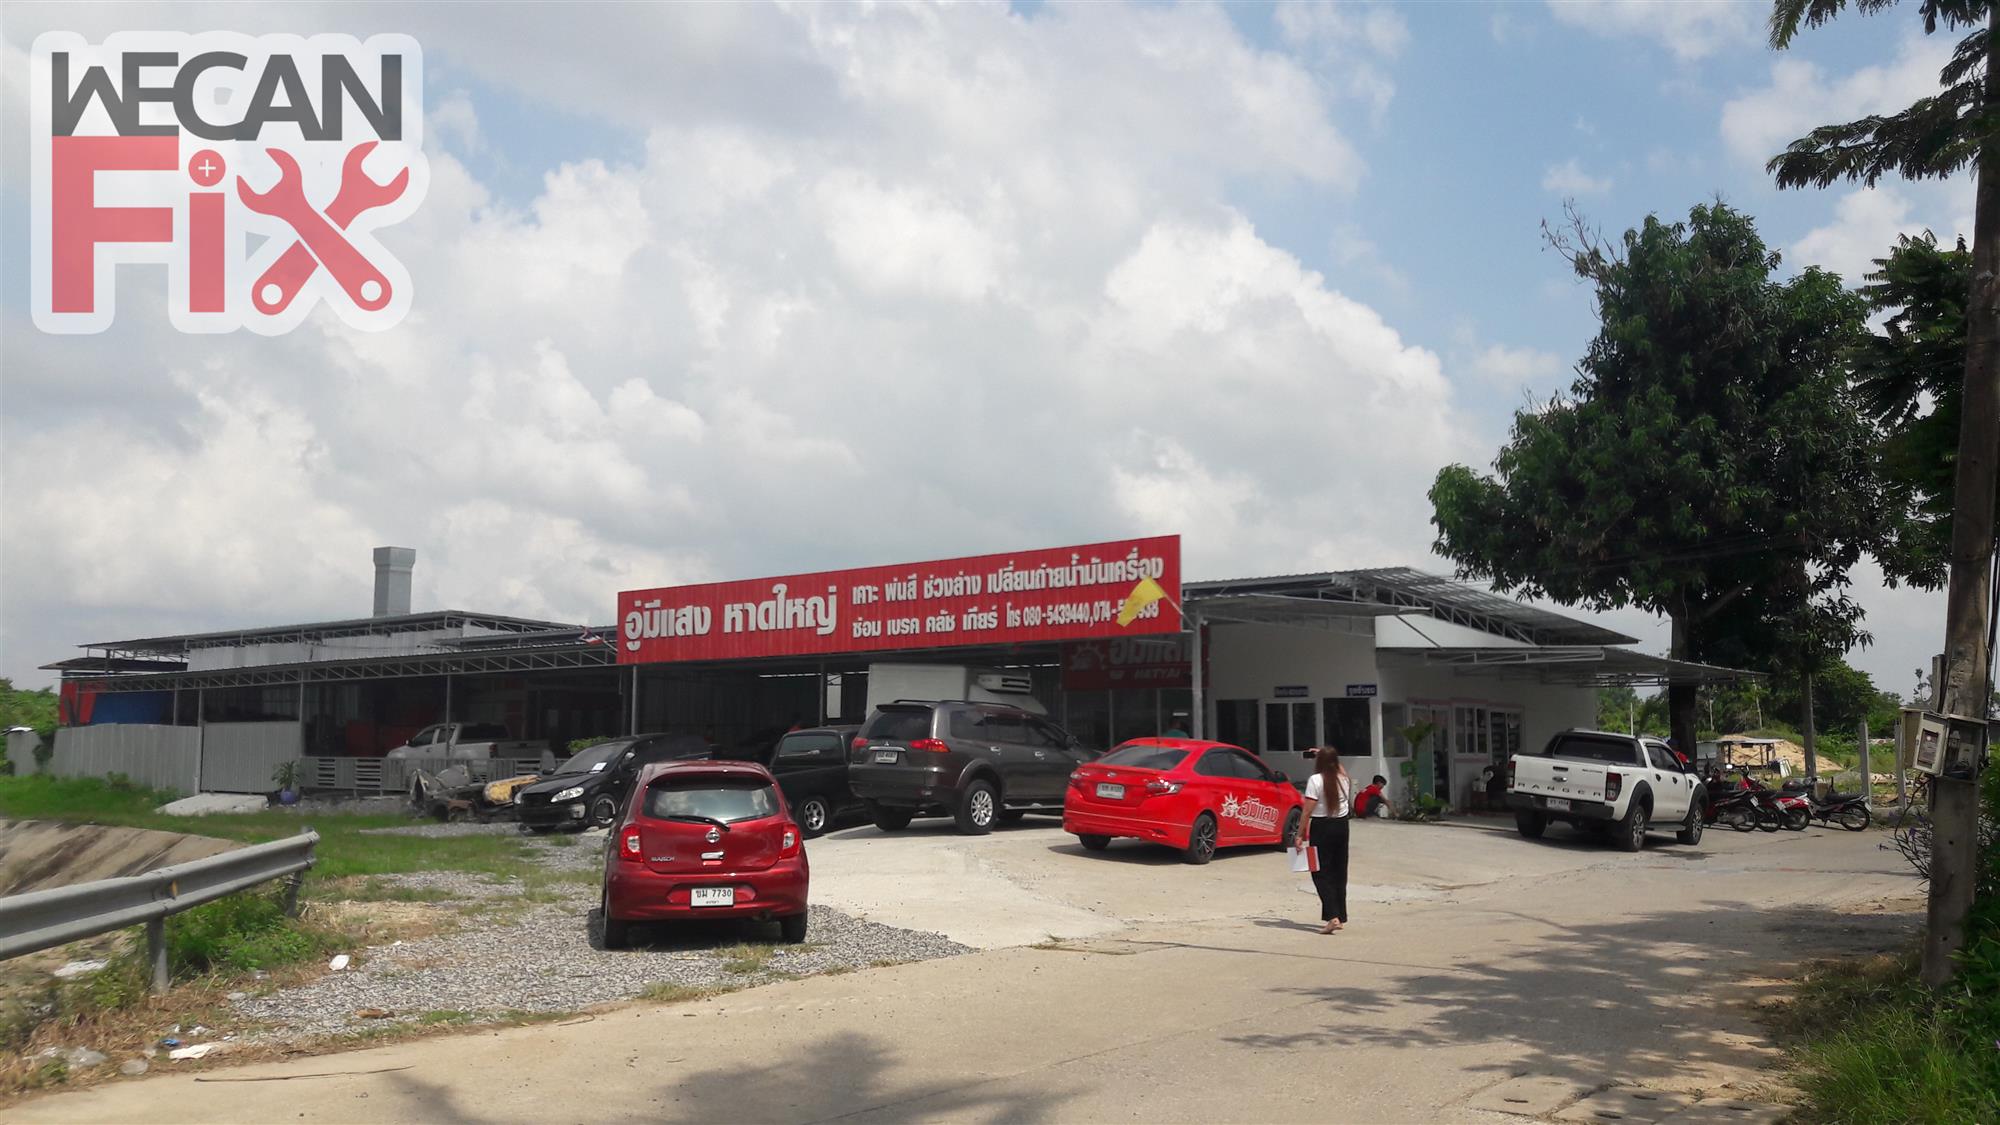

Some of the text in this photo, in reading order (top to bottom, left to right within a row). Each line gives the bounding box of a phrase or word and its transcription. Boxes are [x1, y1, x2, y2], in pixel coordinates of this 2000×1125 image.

[852, 547, 1164, 605] เคาะ พ่นสี ช่วงล่าง เปลี่ยนถ่ายน้ำมันเครื่อง
[625, 583, 837, 651] อู่มีแสง หาดใหญ่
[852, 617, 882, 638] ซ่อม
[887, 617, 920, 636] เบรค
[963, 605, 998, 631] เกียร์
[712, 888, 732, 898] 7730
